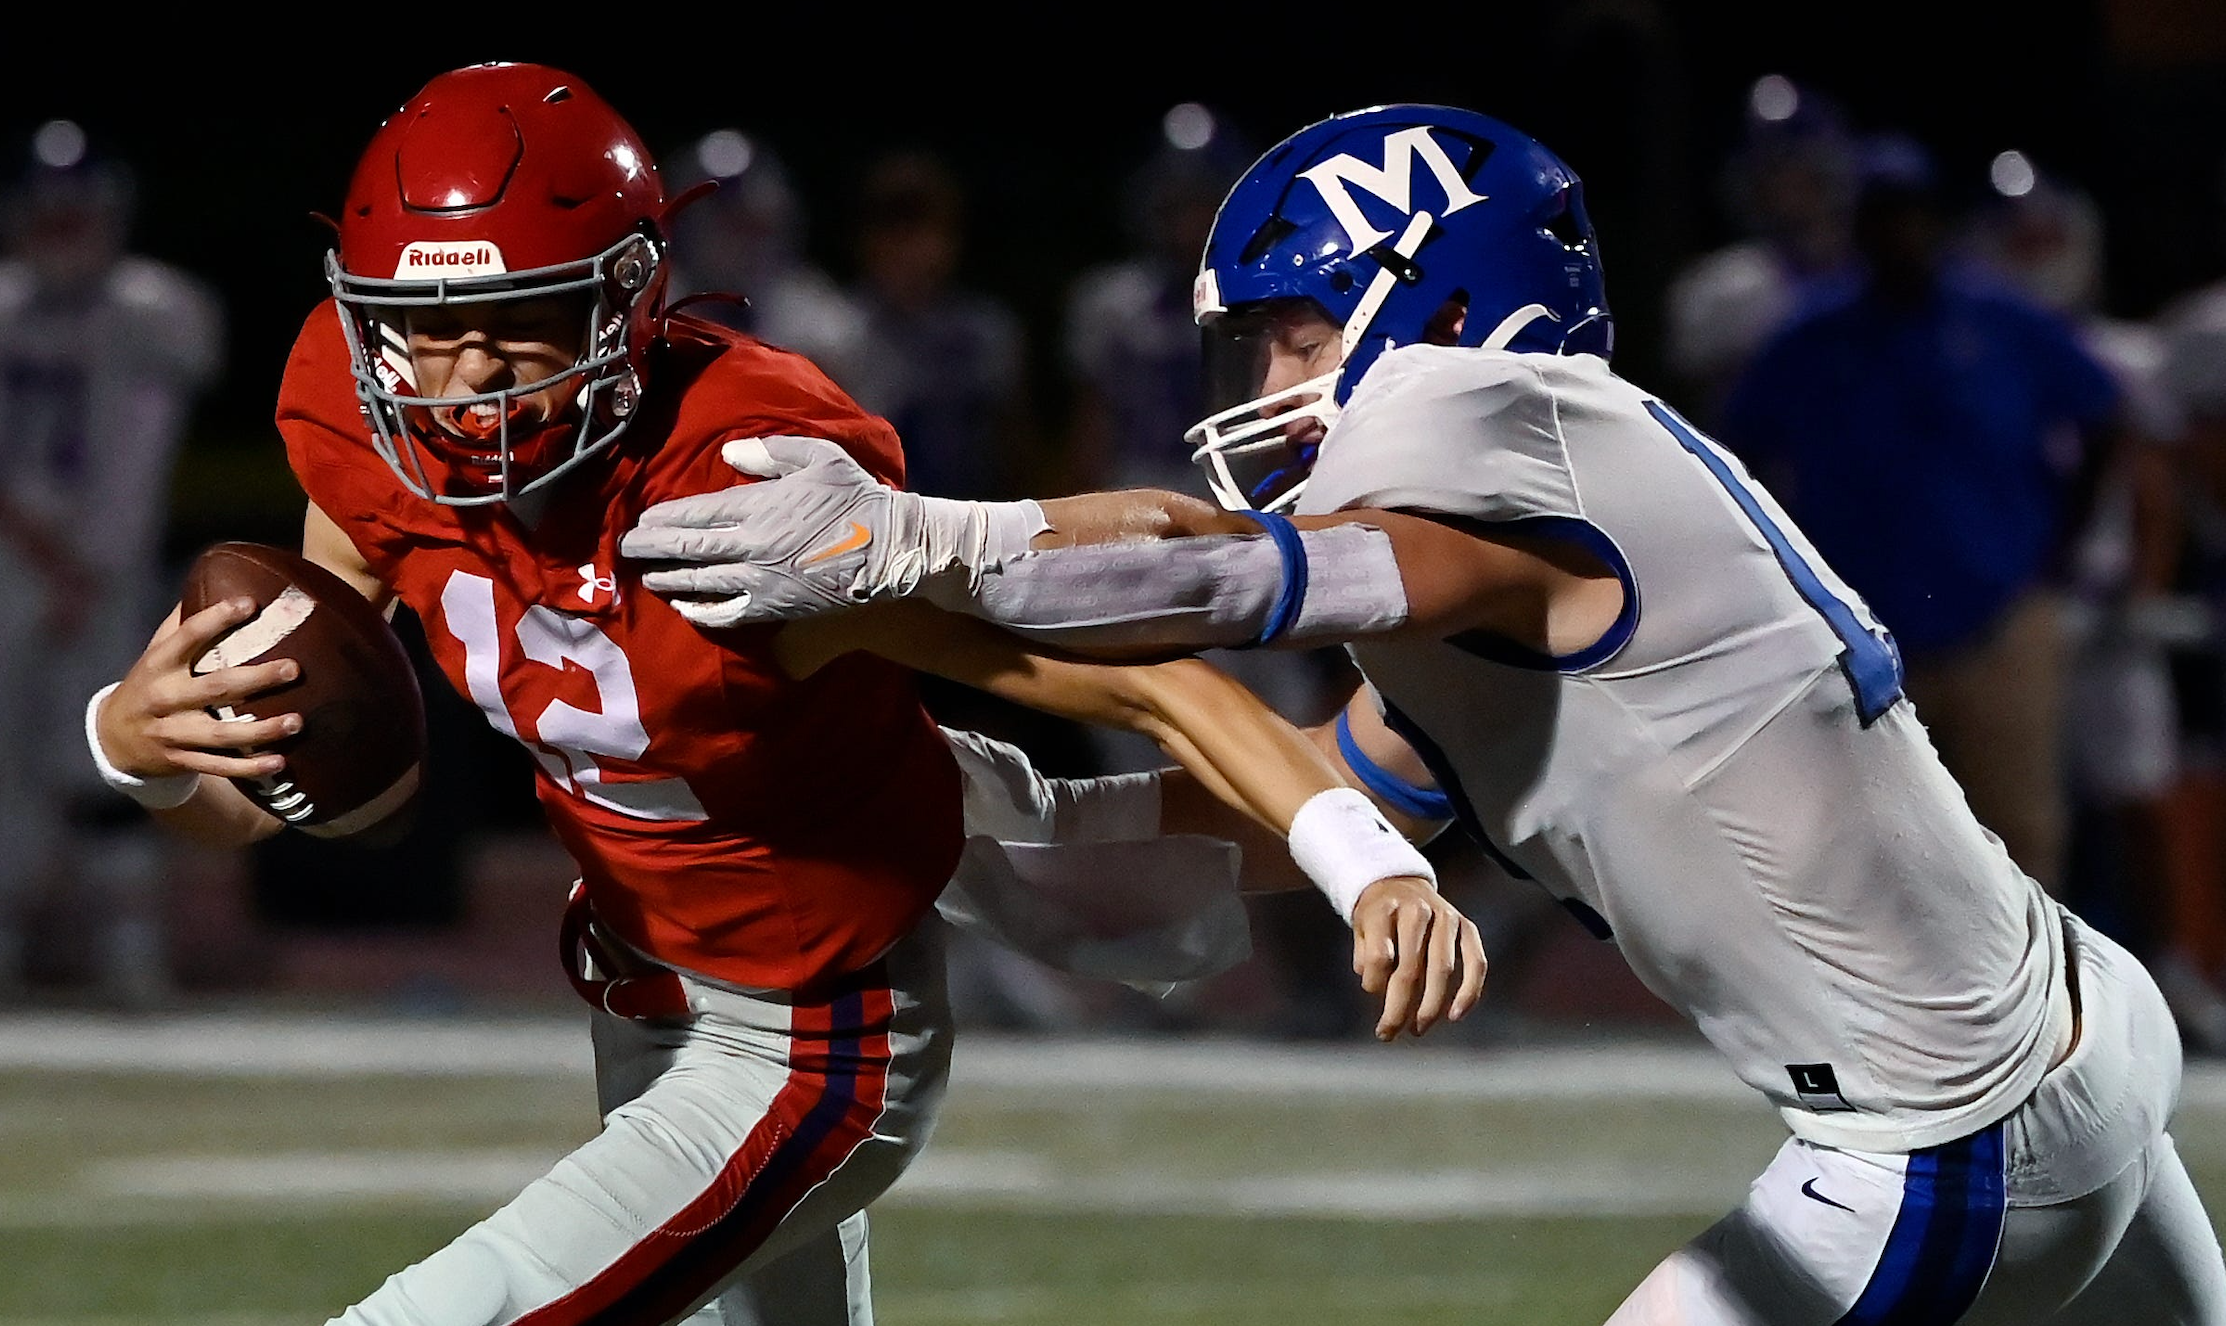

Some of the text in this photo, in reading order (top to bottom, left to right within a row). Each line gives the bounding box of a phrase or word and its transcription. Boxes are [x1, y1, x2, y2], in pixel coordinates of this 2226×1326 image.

[1296, 125, 1489, 260] M
[409, 248, 490, 266] Riddell
[441, 569, 711, 821] 12
[1803, 1071, 1820, 1087] L
